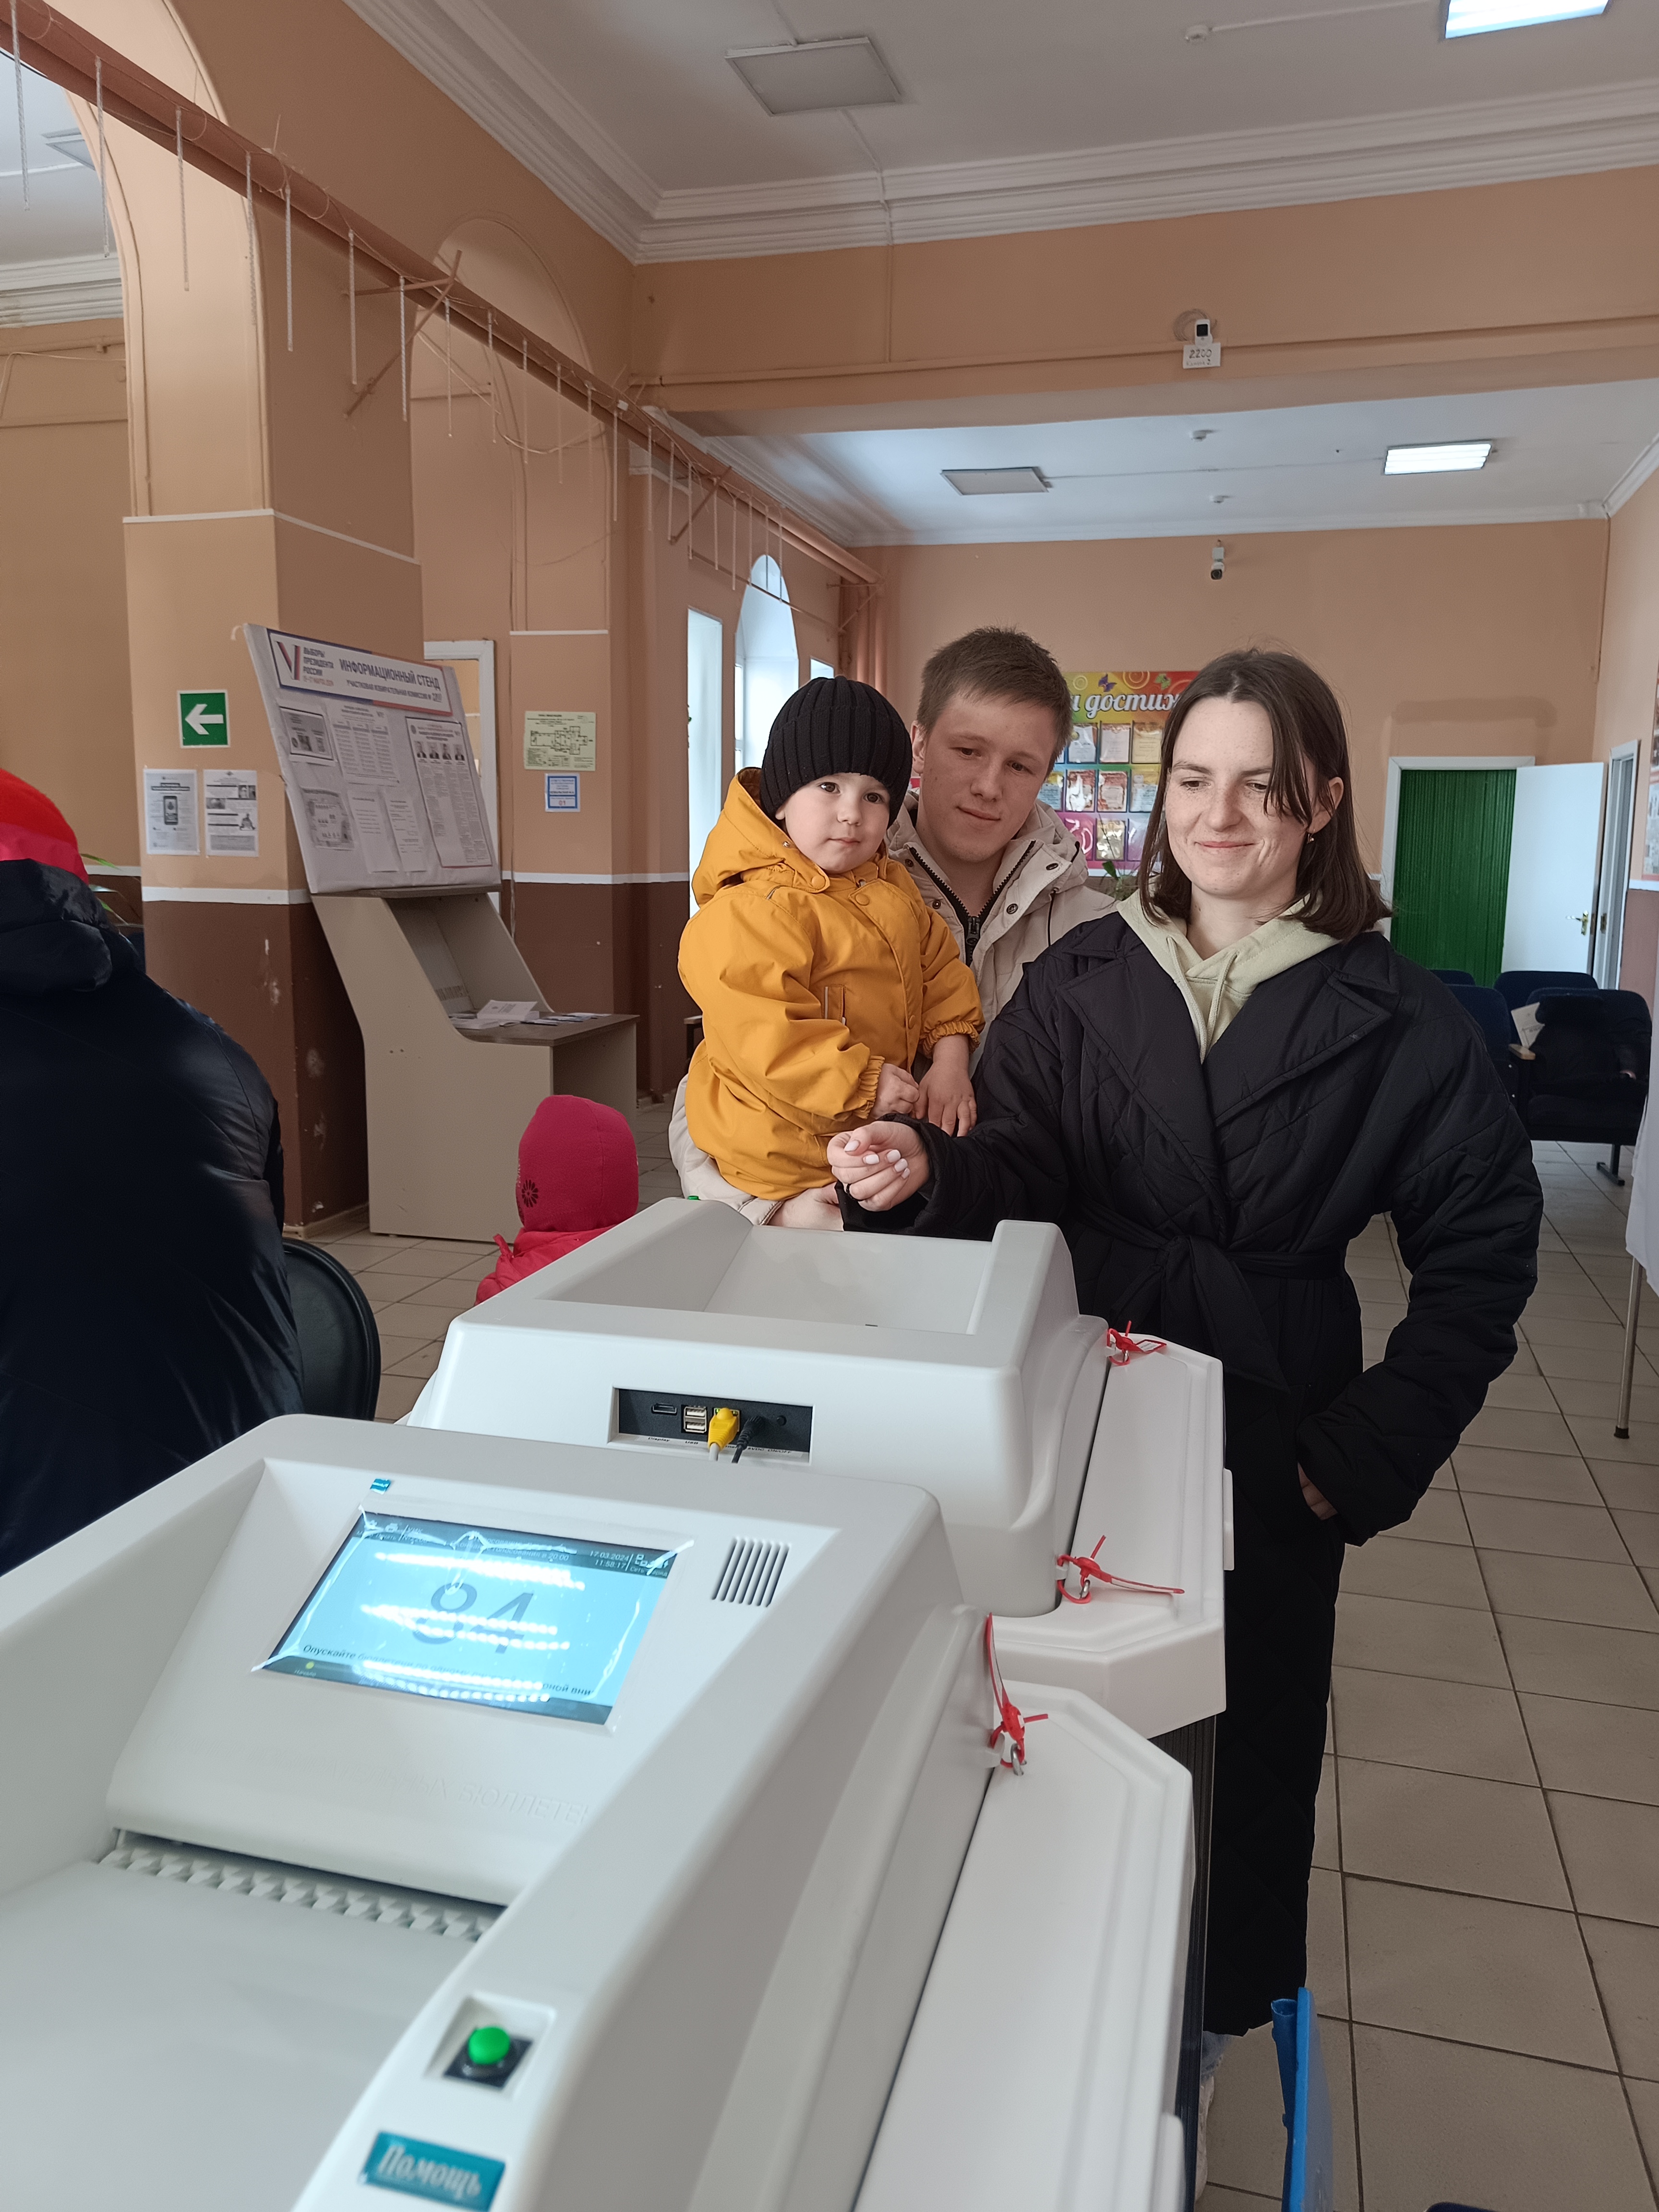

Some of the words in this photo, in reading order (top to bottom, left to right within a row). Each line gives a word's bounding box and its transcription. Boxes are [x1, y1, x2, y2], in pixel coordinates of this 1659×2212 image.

[339, 659, 417, 685] ИНФОРМАЦИОННЫЙ
[417, 674, 441, 691] СТЕНД
[590, 1551, 629, 1562] 17.03.2024
[595, 1560, 627, 1569] 11:58:17
[303, 1645, 356, 1659] Опускайте
[377, 2144, 481, 2200] Помощь
